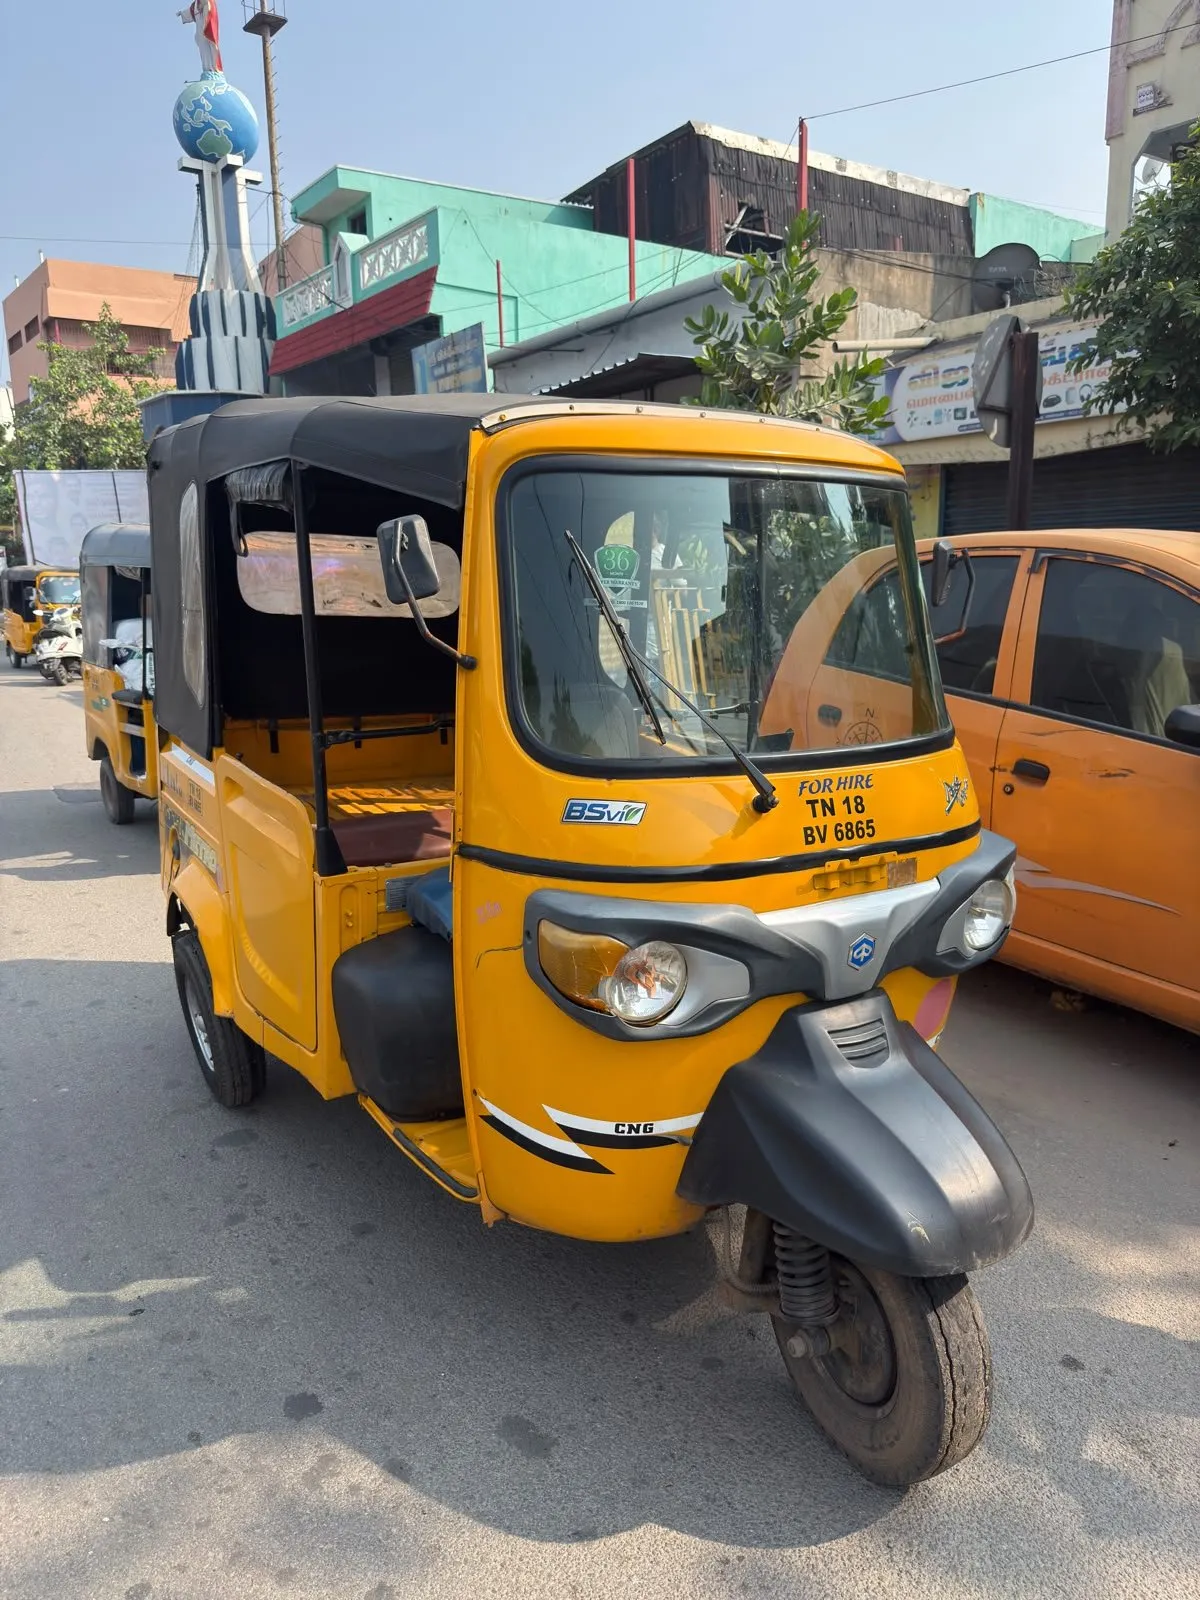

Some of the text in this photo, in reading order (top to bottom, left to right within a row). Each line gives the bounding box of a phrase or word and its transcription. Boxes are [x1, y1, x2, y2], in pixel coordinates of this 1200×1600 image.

[604, 550, 630, 571] 36
[798, 773, 874, 797] FOR HIRE
[805, 795, 865, 818] TN 18
[803, 819, 876, 845] BV 6865
[614, 1122, 654, 1135] CNG
